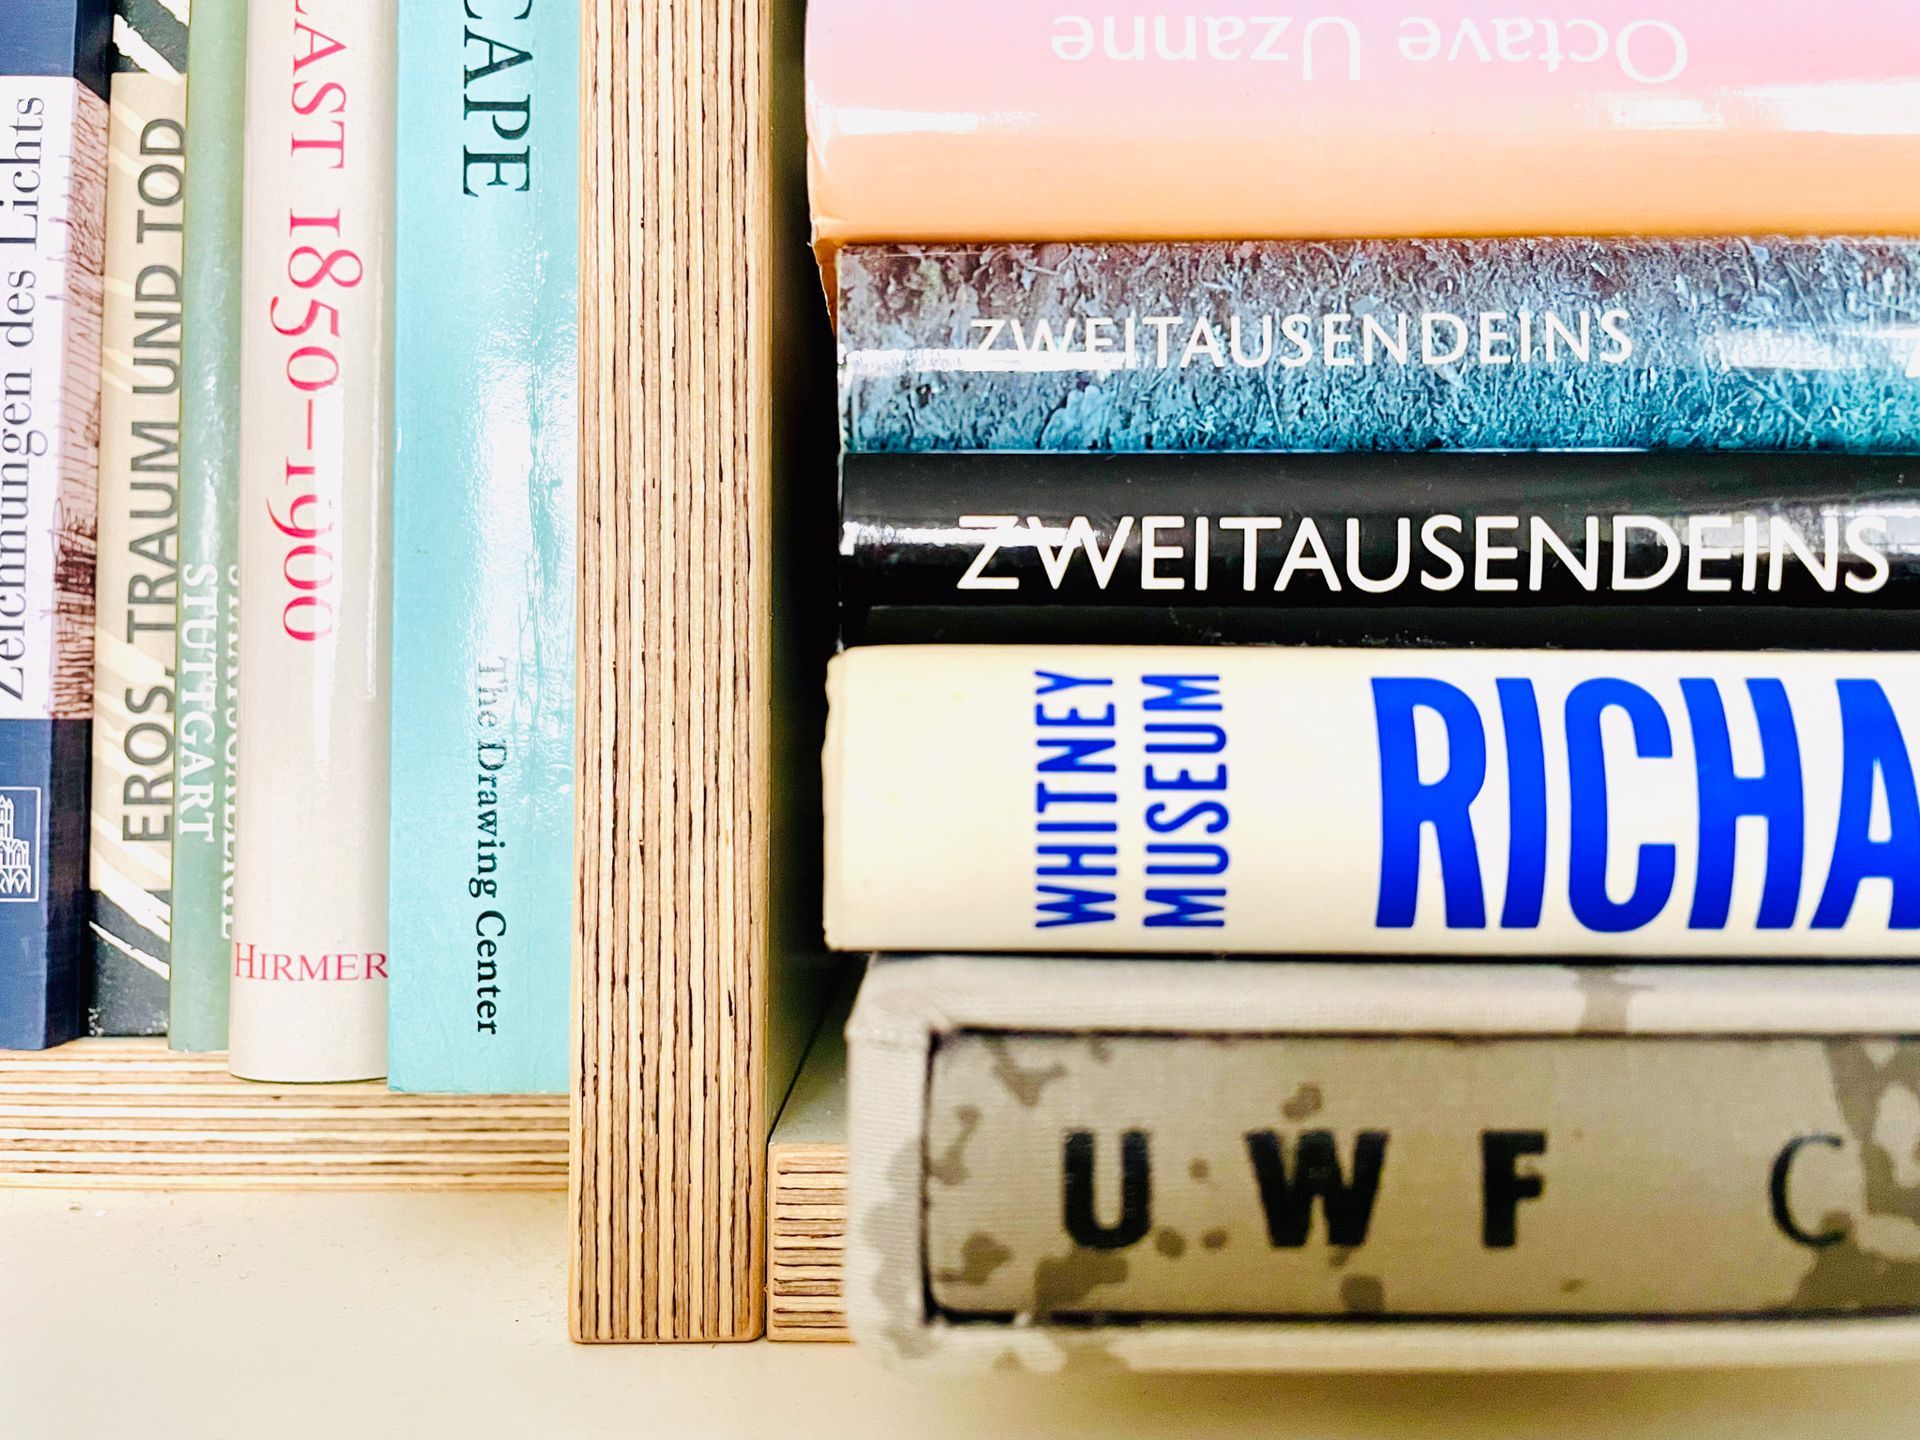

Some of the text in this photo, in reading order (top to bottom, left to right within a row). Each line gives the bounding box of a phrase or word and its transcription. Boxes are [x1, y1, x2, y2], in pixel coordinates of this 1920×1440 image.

[291, 0, 347, 169] AST
[1051, 14, 1689, 84] Octave Uzanne
[0, 97, 44, 250] Lichts
[136, 117, 187, 244] TOD
[0, 270, 36, 347] des
[132, 264, 182, 396] UND
[970, 309, 1632, 368] ZWEITAUSENDEINS
[127, 421, 180, 644] TRAUM
[957, 515, 1890, 593] ZWEITAUSENDEINS
[178, 563, 219, 843] STUTTGART
[468, 738, 508, 900] Drawing
[1035, 671, 1117, 927] WHITNEY
[1142, 675, 1229, 927] MUSEUM
[233, 942, 389, 981] HIRMER
[474, 910, 507, 1036] Center
